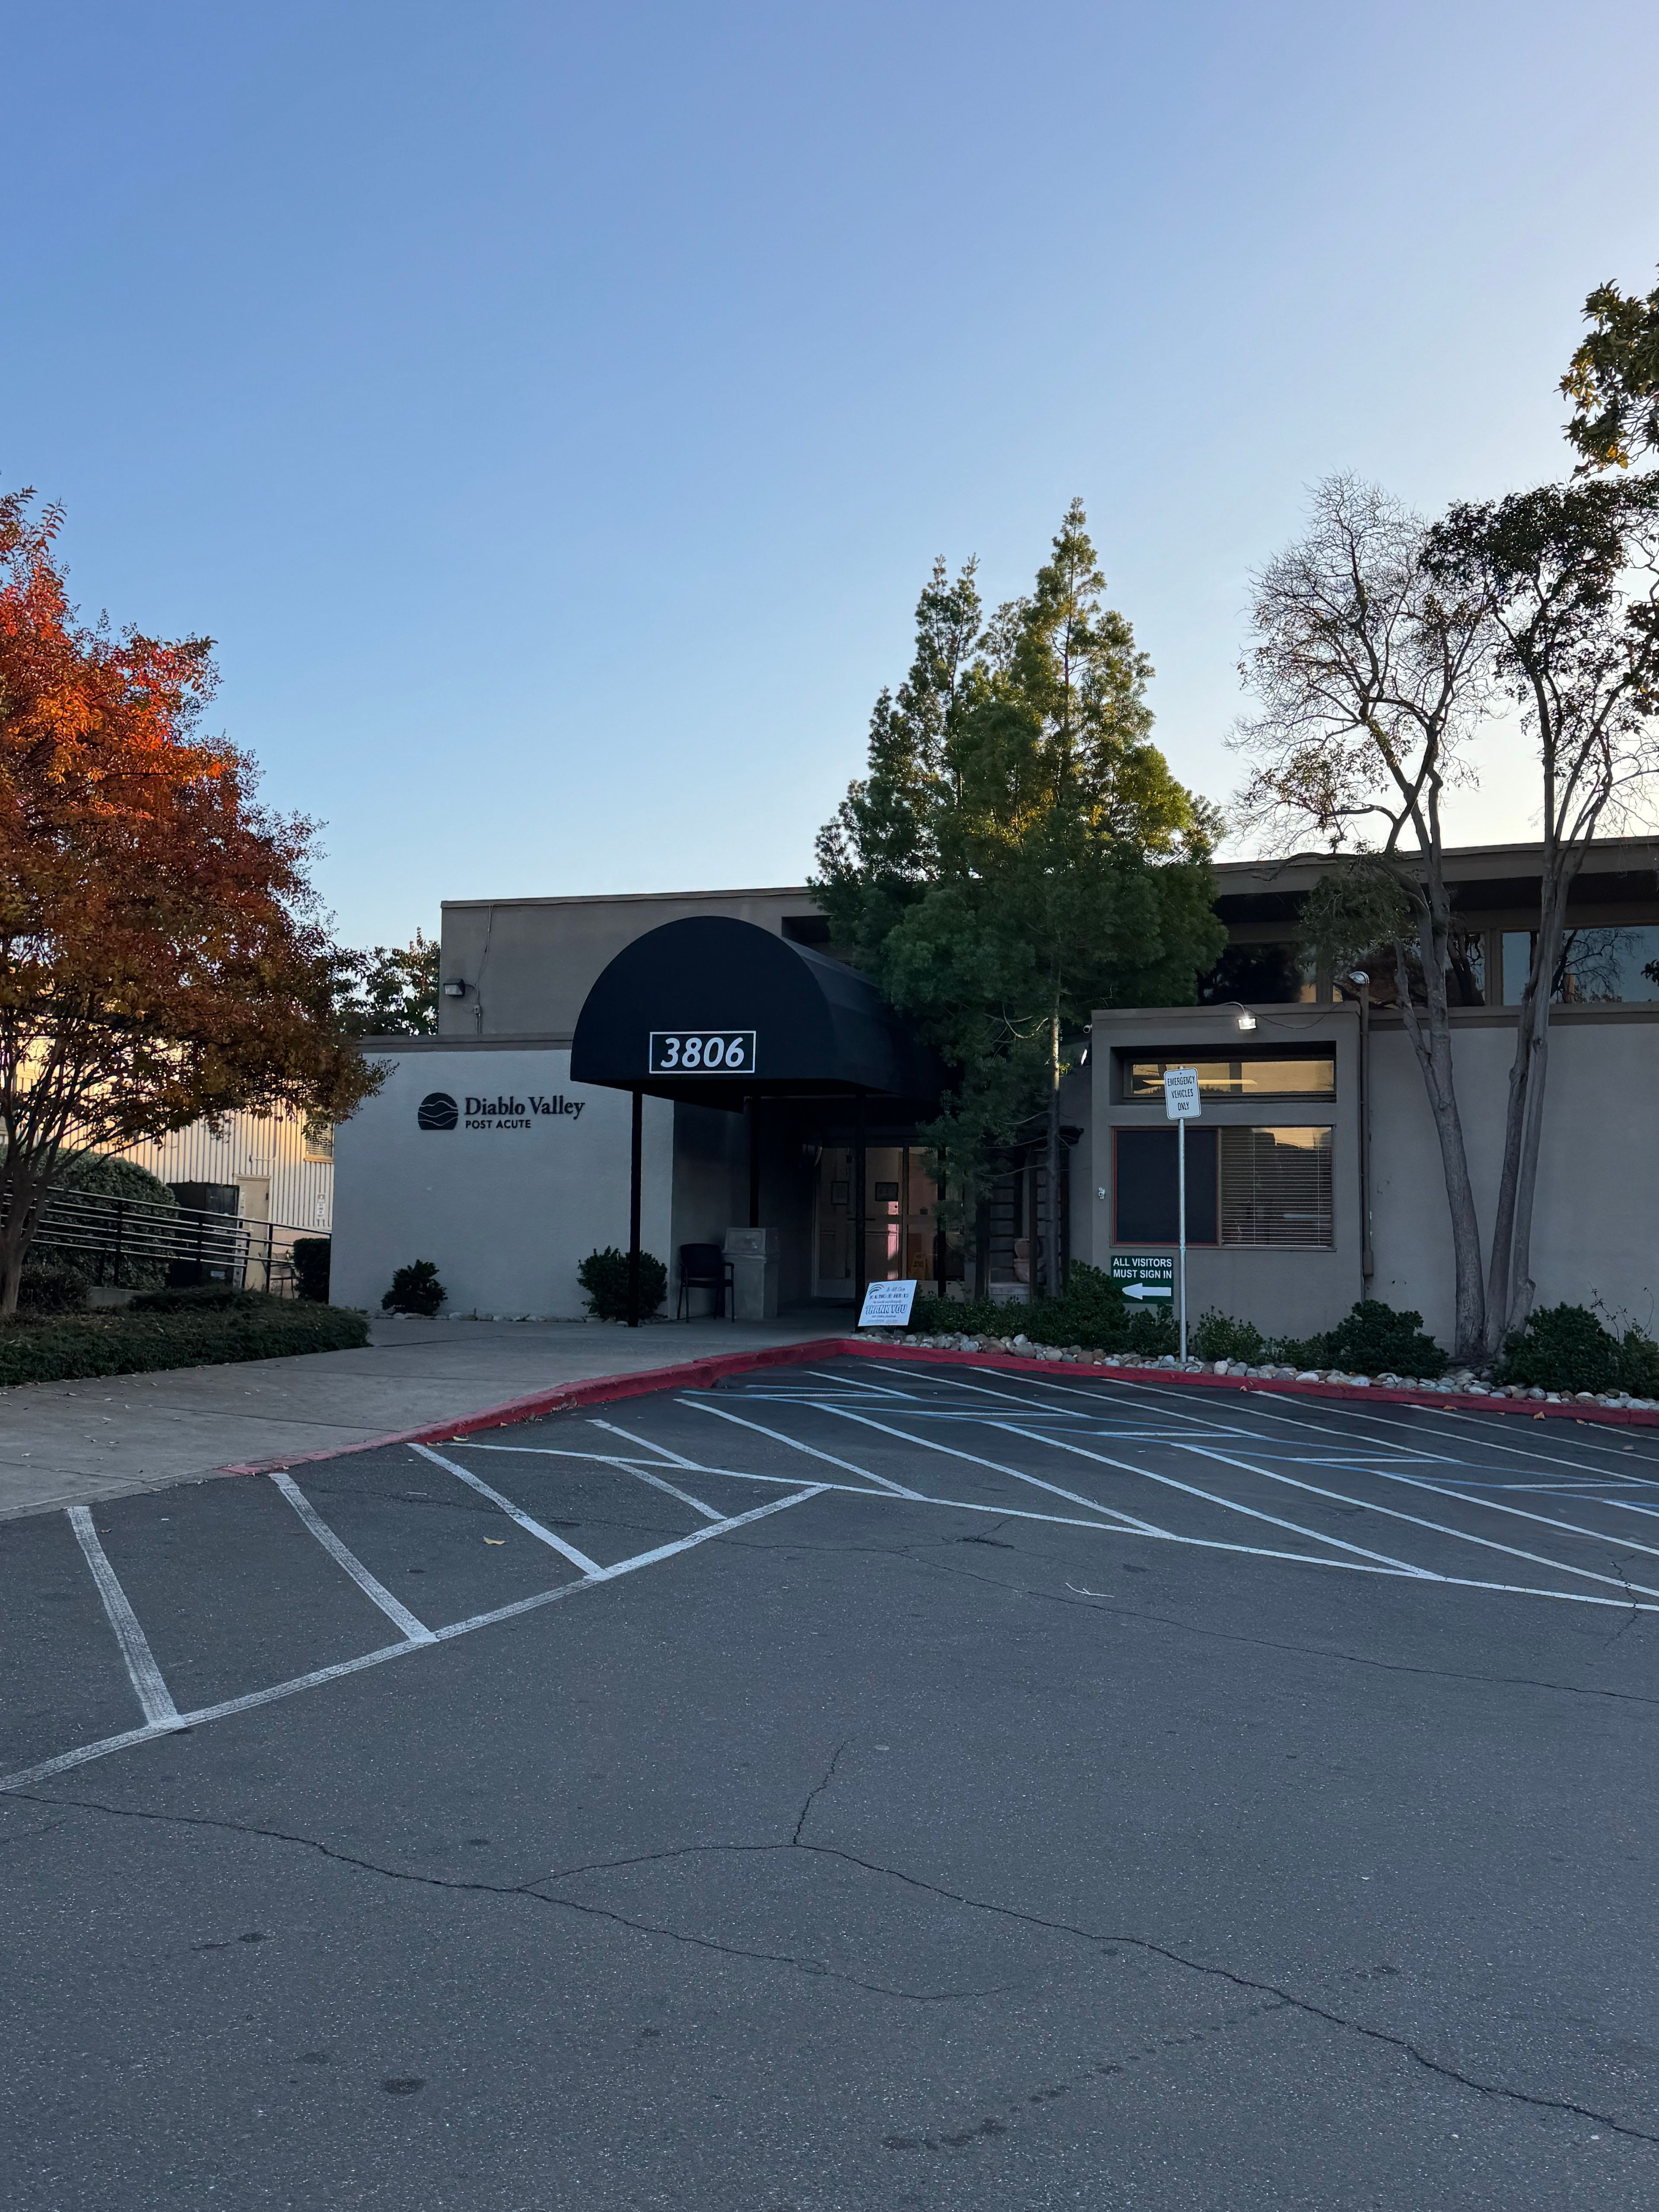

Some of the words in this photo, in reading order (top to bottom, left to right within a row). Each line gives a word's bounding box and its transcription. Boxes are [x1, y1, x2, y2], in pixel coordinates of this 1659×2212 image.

[660, 1037, 744, 1068] 3806
[1167, 1075, 1195, 1086] EMERGENCY
[1171, 1089, 1193, 1099] VEHICLES
[464, 1096, 526, 1116] Diablo
[528, 1095, 586, 1120] Valley
[1178, 1102, 1189, 1111] ONLY
[466, 1120, 493, 1129] POST
[496, 1119, 531, 1128] ACUTE
[1113, 1258, 1130, 1266] ALL
[1132, 1258, 1172, 1267] VISITORS
[1113, 1269, 1138, 1278] MUST
[1140, 1270, 1161, 1279] SIGN
[1163, 1270, 1172, 1279] IN
[866, 1304, 891, 1315] THANK
[891, 1304, 908, 1314] YOU
